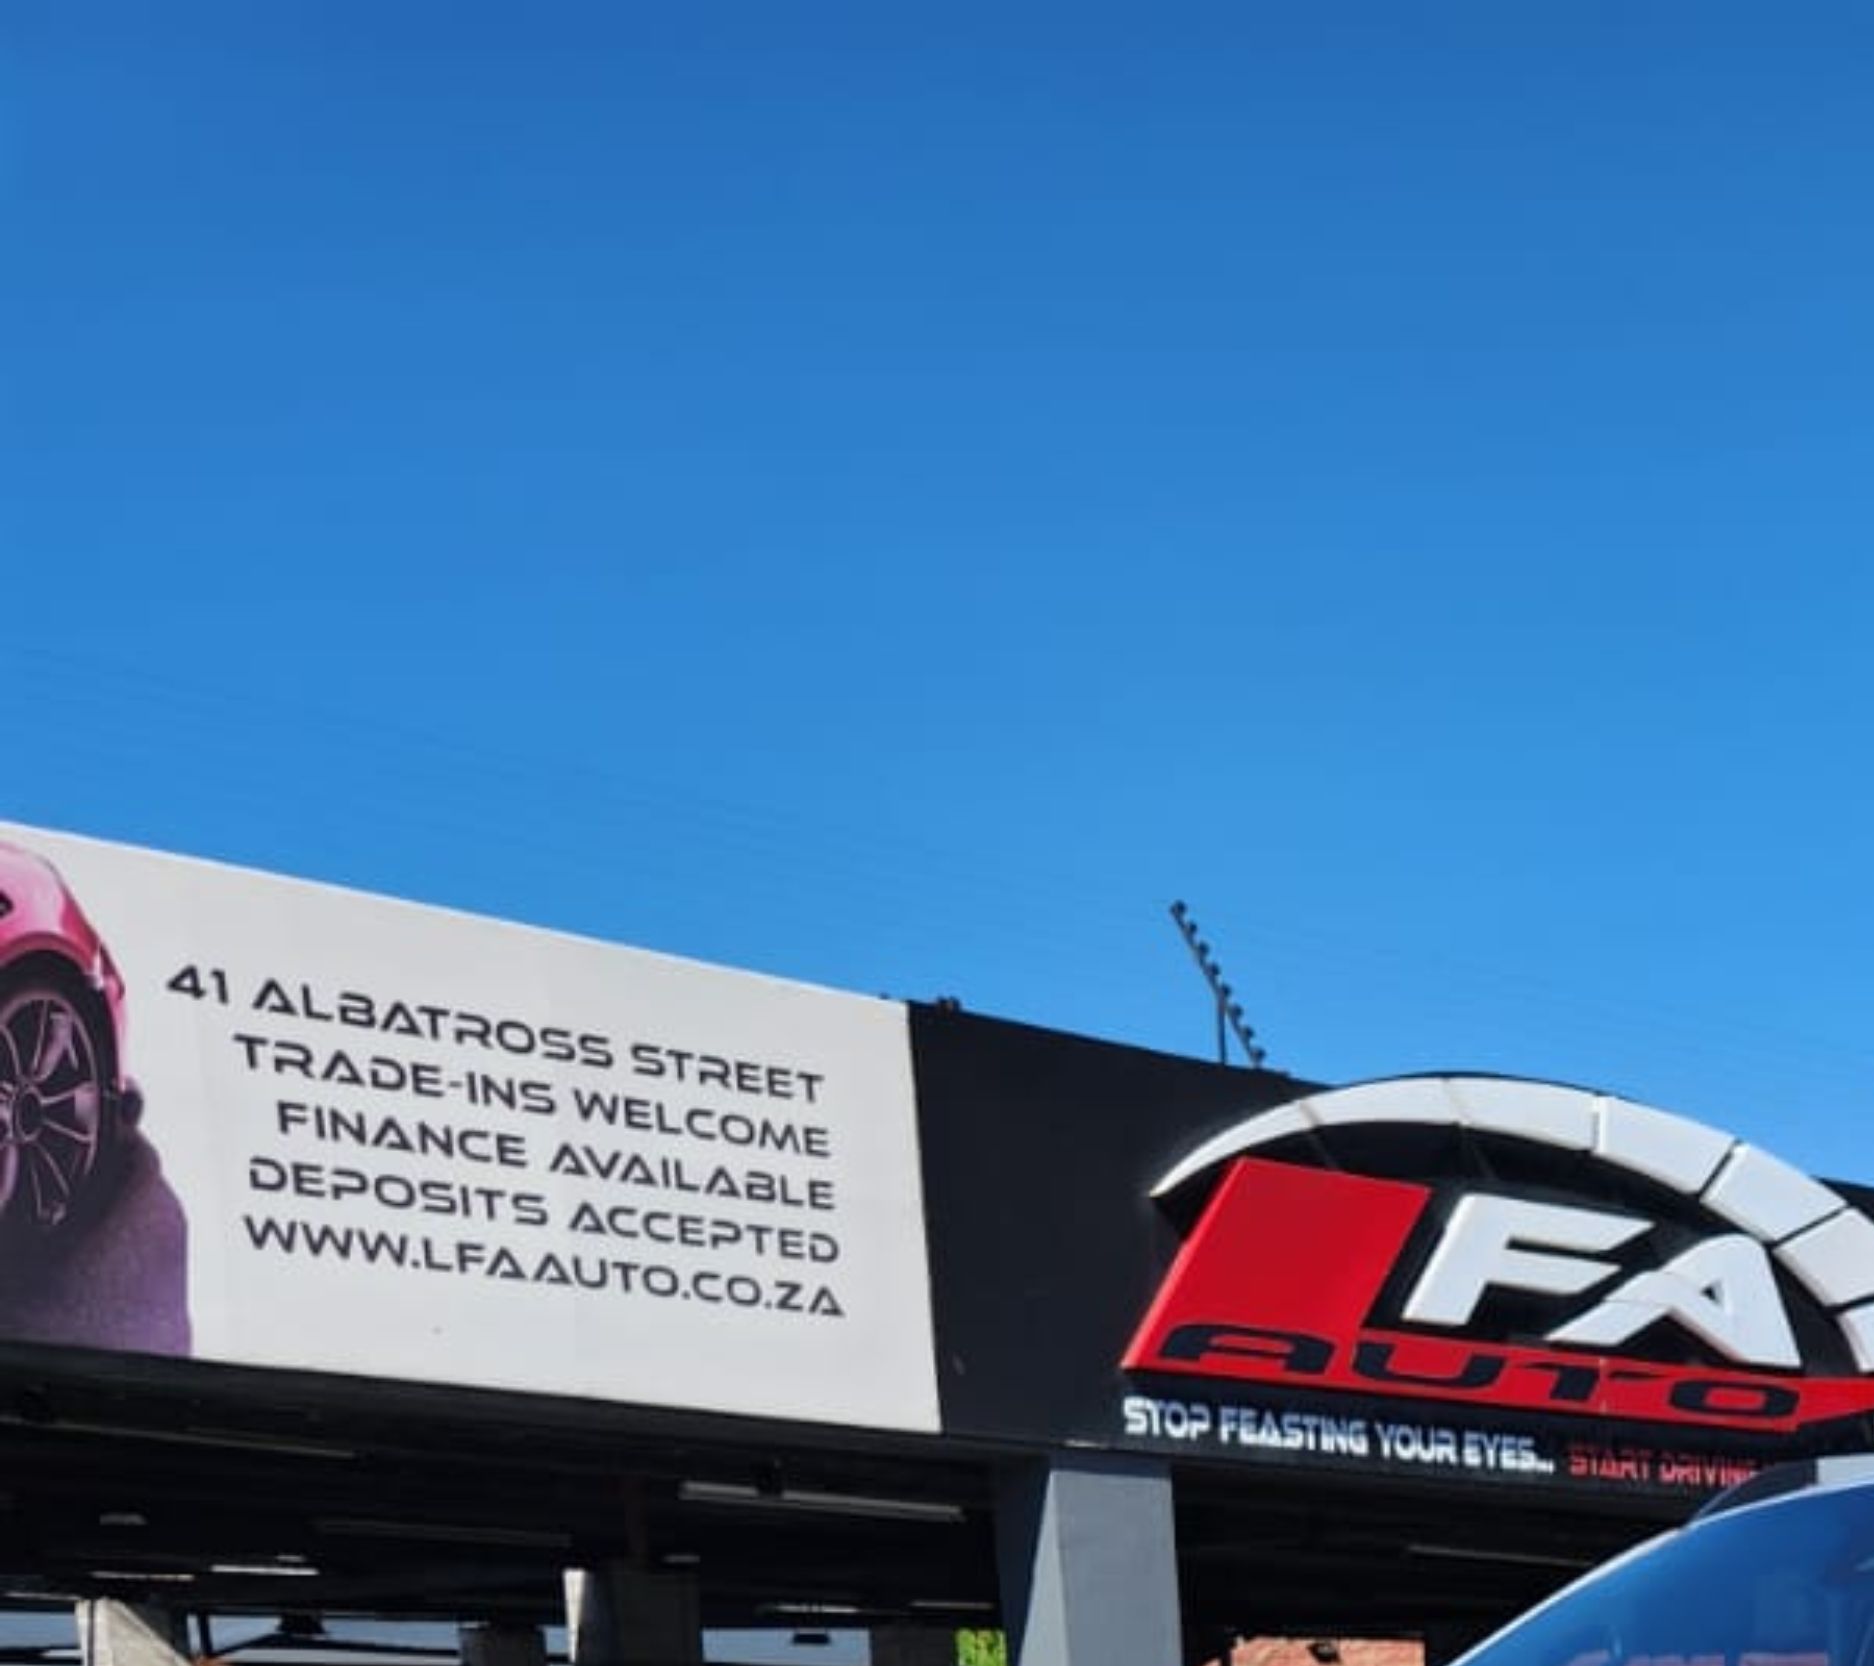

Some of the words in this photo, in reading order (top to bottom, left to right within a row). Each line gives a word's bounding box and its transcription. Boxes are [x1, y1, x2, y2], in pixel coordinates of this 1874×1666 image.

[166, 965, 230, 1006] 41
[252, 976, 613, 1069] ALBATROSS
[631, 1044, 824, 1106] STREET
[233, 1034, 557, 1116] TRADE-INS
[573, 1088, 830, 1159] WELCOME
[277, 1102, 528, 1168] FINANCE
[548, 1141, 837, 1211] AVAILABLE
[249, 1157, 548, 1228] DEPOSITS
[568, 1201, 841, 1265] ACCEPTED
[243, 1215, 846, 1319] WWW.LFAAUTO.CO.ZA
[1157, 1323, 1797, 1419] AUTO
[1122, 1396, 1213, 1440] STOP
[1218, 1406, 1370, 1458] FEASTING
[1373, 1421, 1459, 1466] YOUR
[1568, 1442, 1651, 1481] START
